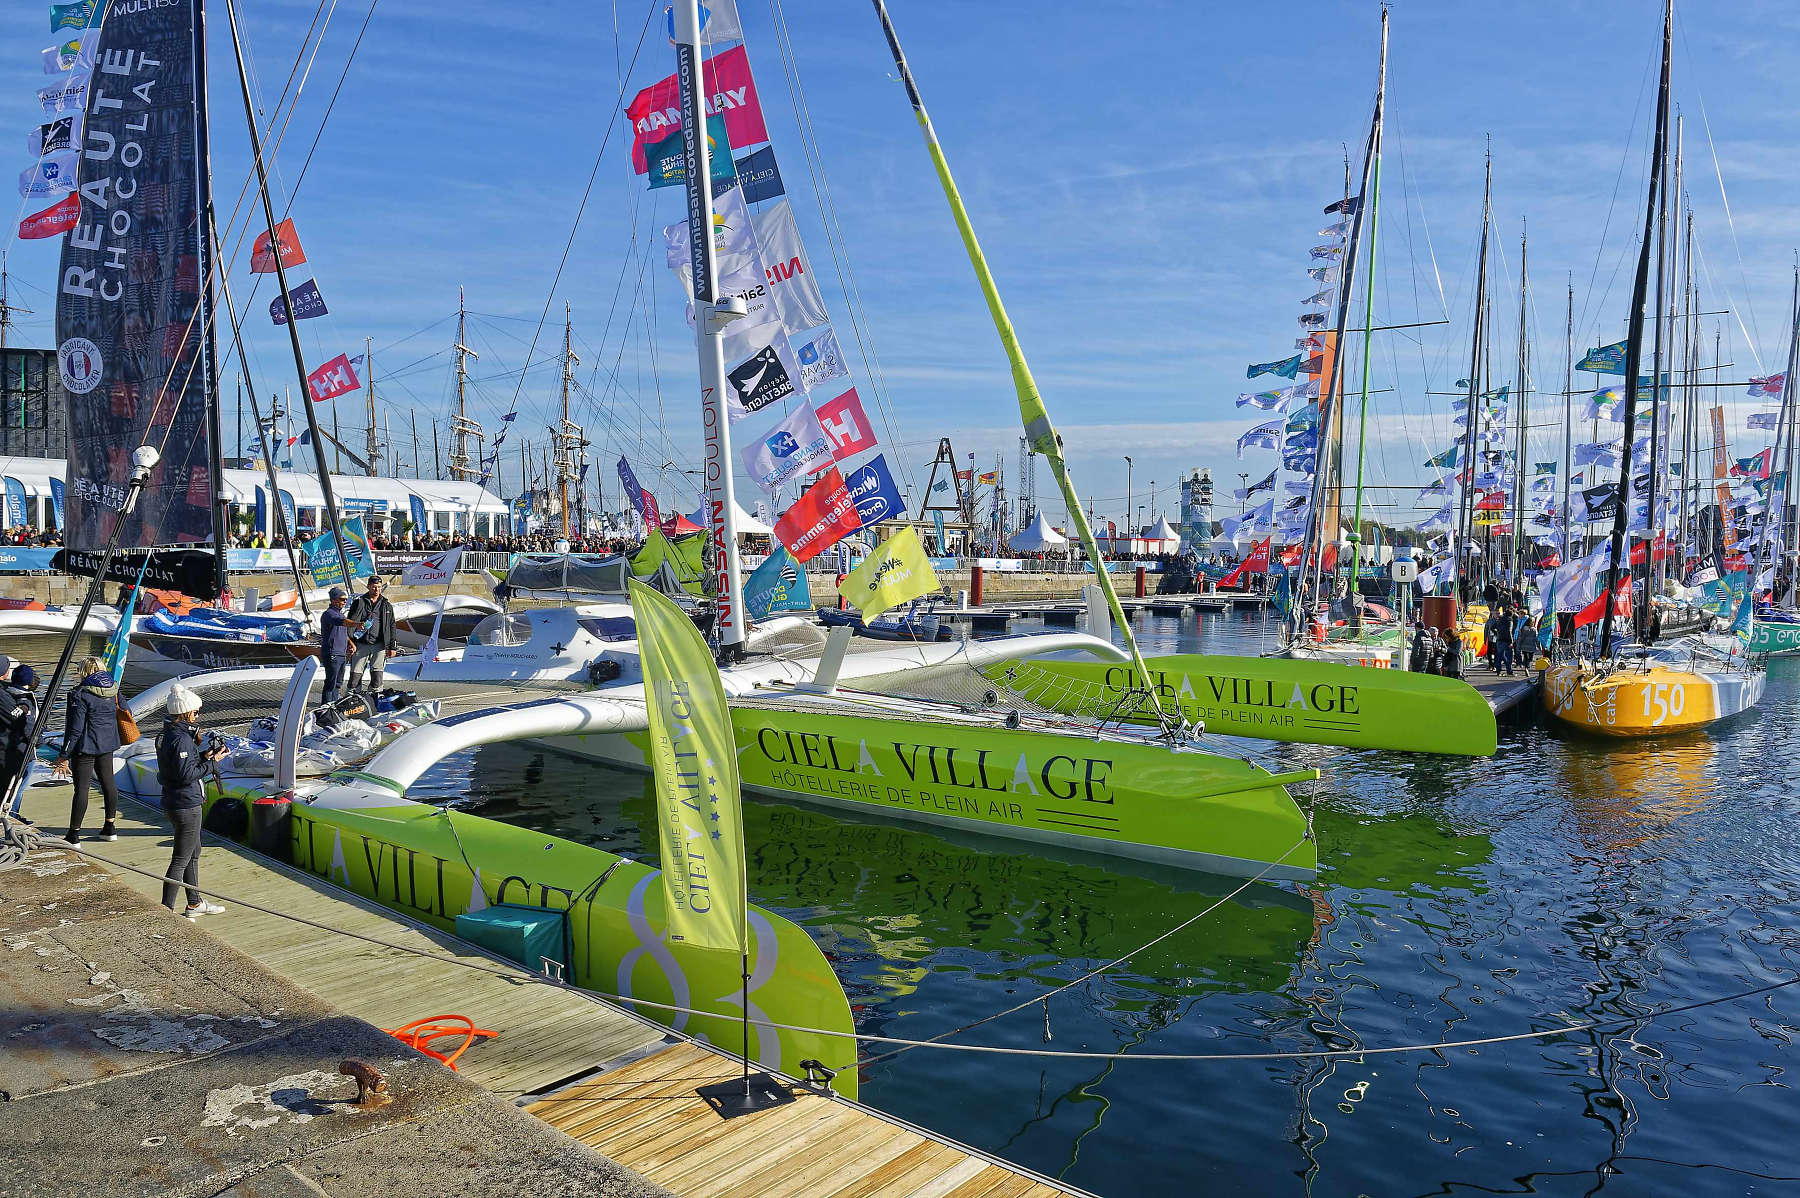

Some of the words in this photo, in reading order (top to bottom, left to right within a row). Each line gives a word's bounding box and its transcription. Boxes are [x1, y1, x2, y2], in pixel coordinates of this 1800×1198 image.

[101, 51, 161, 301] CHOCOLAT
[677, 47, 704, 294] www.nissan-cotedazur.com
[62, 369, 101, 391] CHOCOLATIER
[702, 387, 722, 495] TOULON
[70, 554, 112, 573] RÉAUÉ
[399, 555, 422, 564] régional
[712, 500, 732, 628] NISSAN
[1400, 565, 1407, 577] B
[1196, 705, 1217, 720] DE
[1220, 708, 1264, 725] PLEIN
[1269, 714, 1296, 728] AIR
[1206, 675, 1360, 714] VILLAGE
[1641, 682, 1685, 727] 150
[757, 726, 885, 777] CIELA
[891, 741, 1115, 806] VILLAGE
[771, 768, 881, 801] HÔTELLERIE
[887, 786, 913, 805] DE
[921, 790, 980, 815] PLEIN
[988, 802, 1025, 821] AIR
